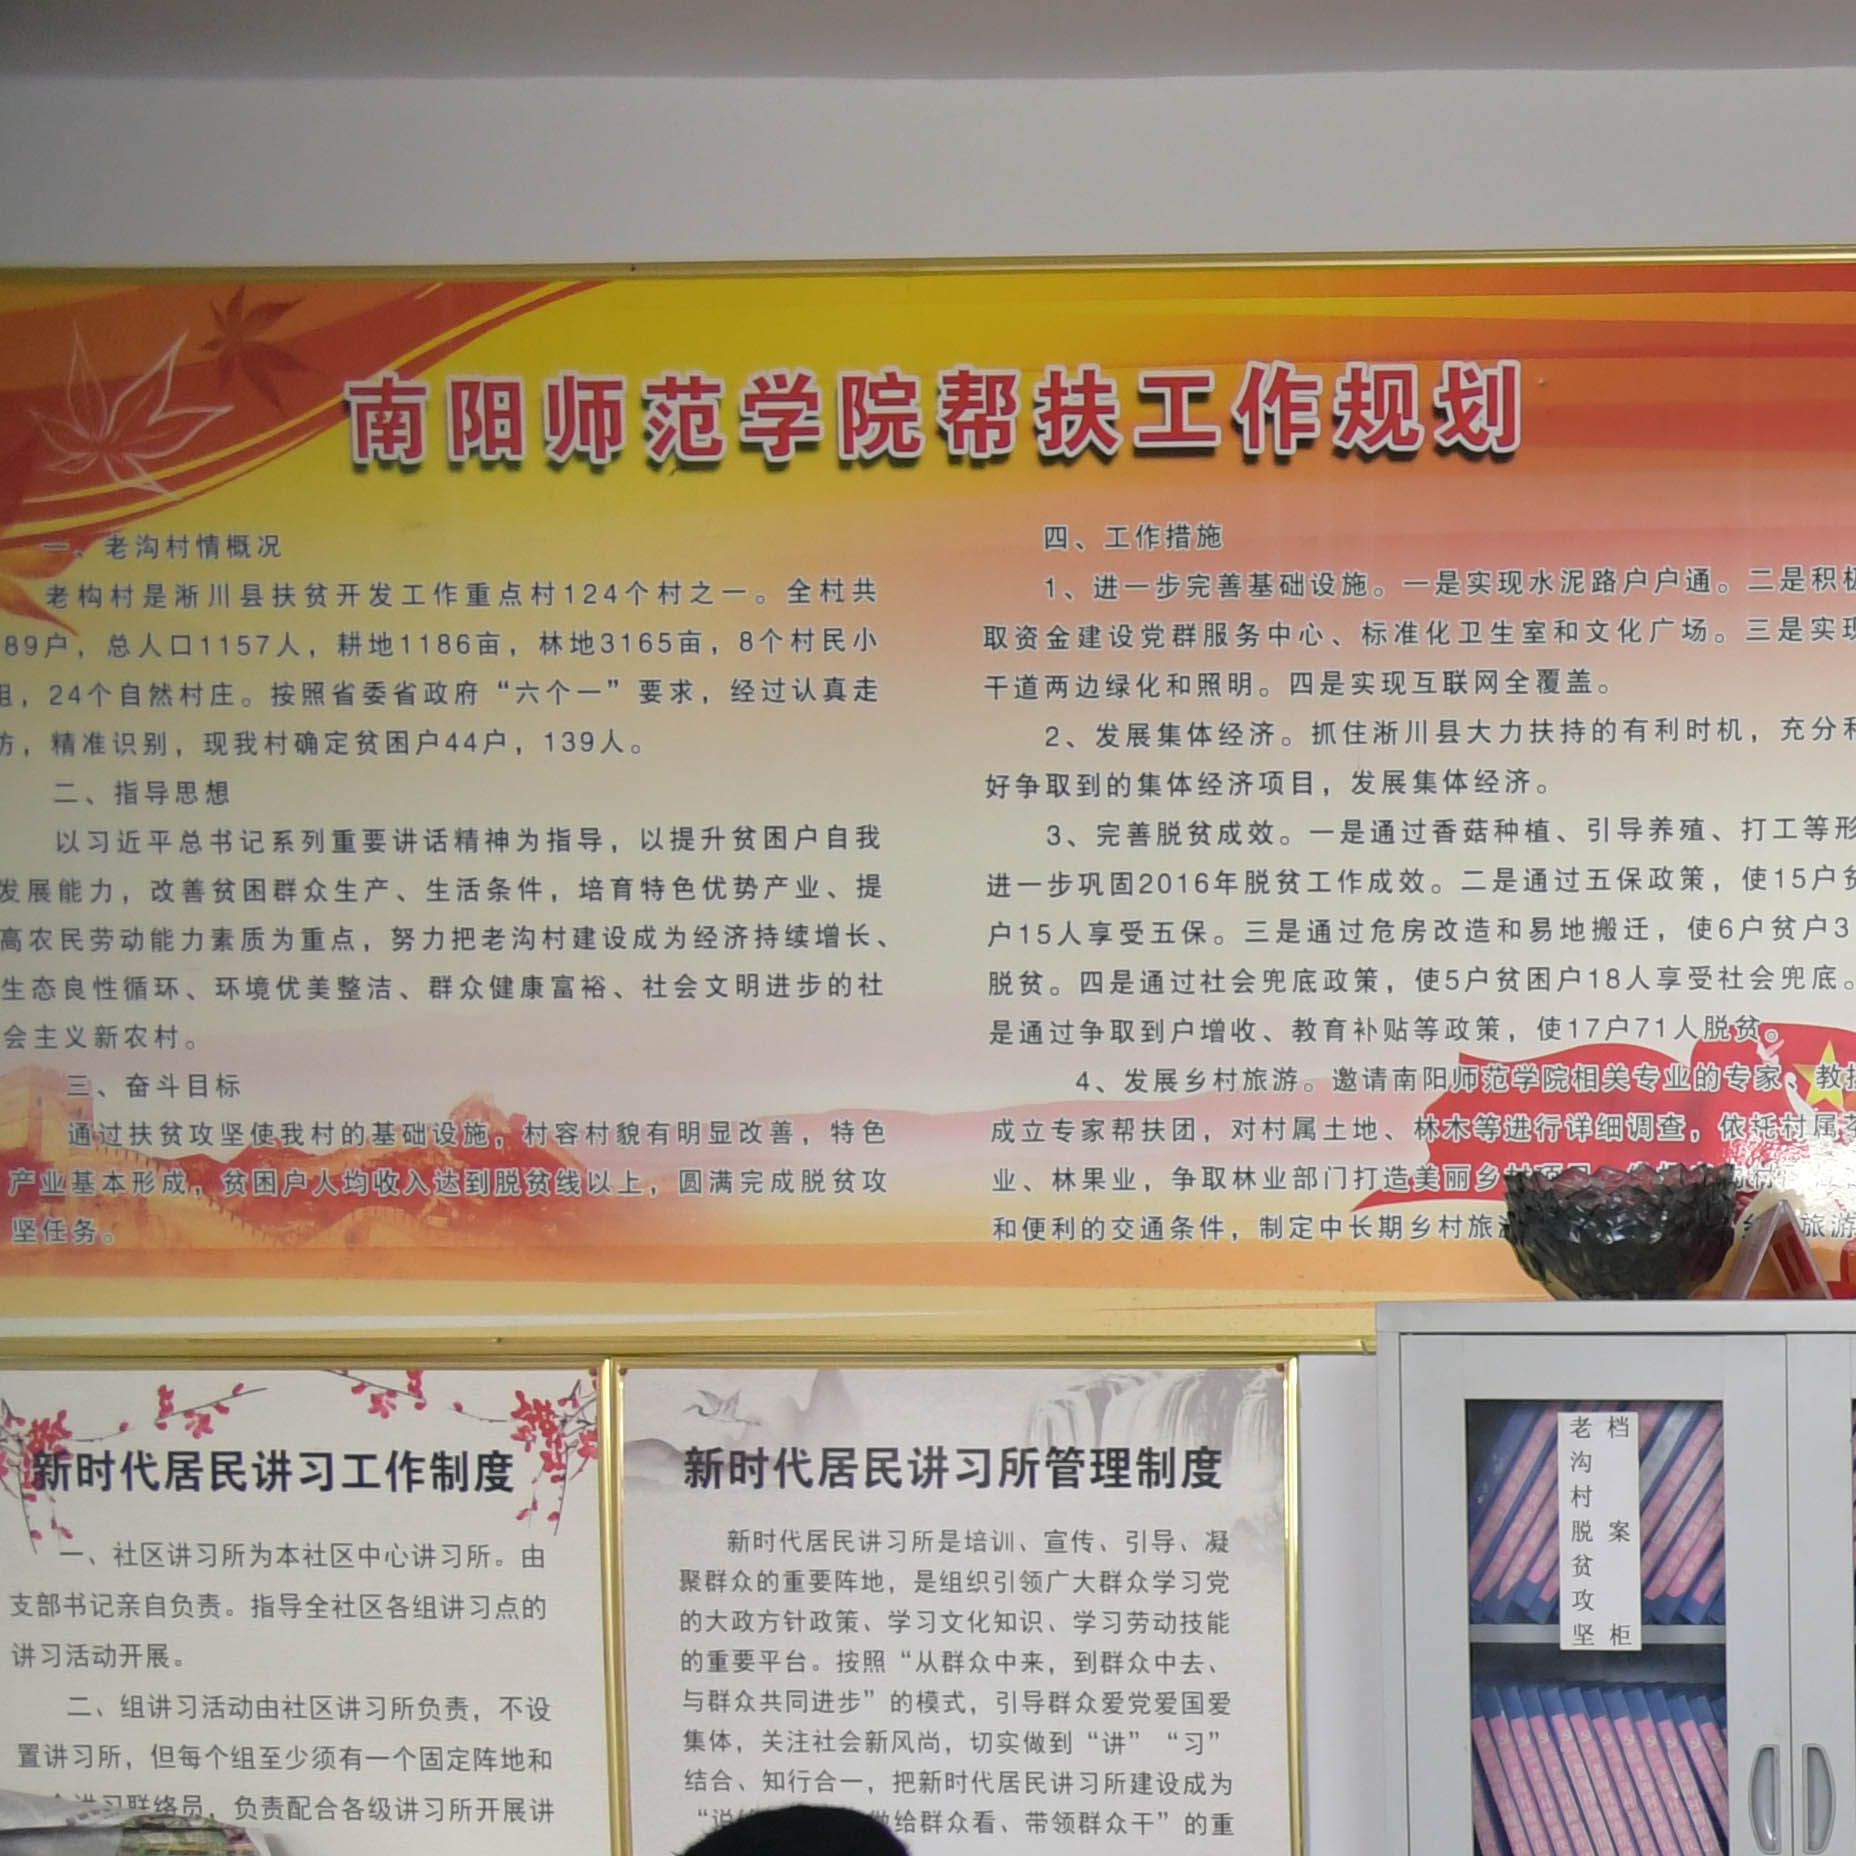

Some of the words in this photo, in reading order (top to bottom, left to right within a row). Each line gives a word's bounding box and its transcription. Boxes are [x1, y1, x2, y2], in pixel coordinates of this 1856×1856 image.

[345, 360, 1523, 465] 南阳师范学院帮扶工作规划
[41, 533, 283, 561] 一、老沟村情概况
[1042, 522, 1225, 552] 四、工作措施
[983, 668, 1612, 702] 干道两边绿化和照明。四是实现互联网全覆盖。
[53, 779, 231, 807] 二、指导思想
[984, 768, 1553, 801] 好争取到的集体经济项目，发展集体经济。
[54, 823, 882, 857] 以习近平总书记系列重要讲话精神为指导，以提升贫困户自我
[0, 922, 893, 954] 高农民劳动能力素质为重点，努力把老沟村建设成为经济持续增长、
[2, 971, 885, 1003] 生态良性循环、环境优美整洁、群众健康富裕、社会文明进步的社
[2, 1023, 200, 1051] 会主义新农村。
[66, 1072, 242, 1100] 三、奋斗目标
[68, 1118, 888, 1150] 通过扶贫攻坚使我村的基础设施，村容村貌有明显改善，特色
[8, 1166, 890, 1198] 产业基本形成，贫困户人均收入达到脱贫线以上，圆满完成脱贫攻
[11, 1218, 116, 1246] 坚任务。
[31, 1448, 516, 1494] 新时代居民讲习工作制度
[683, 1445, 1223, 1490] 新时代居民讲习所管理制度
[726, 1528, 1230, 1556] 新时代居民讲习所是培训、宣传、引导、凝
[1570, 1416, 1595, 1646] 老沟村脱贫攻坚
[59, 1543, 545, 1570] 一、社区讲习所为本社区中心讲习所。由
[679, 1569, 1230, 1597] 聚群众的重要阵地，是组织引领广大群众学习党
[9, 1592, 548, 1620] 支部书记亲自负责。指导全社区各组讲习点的
[679, 1609, 1230, 1636] 的大政方针政策、学习文化知识、学习劳动技能
[11, 1642, 183, 1668] 讲习活动开展。
[66, 1694, 552, 1723] 二、组讲习活动由社区讲习所负责，不设
[17, 1744, 553, 1772] 置讲习所，但每个组至少须有一个固定阵地和
[684, 1770, 1233, 1797] 结合、知行合一，把新时代居民讲习所建设成为
